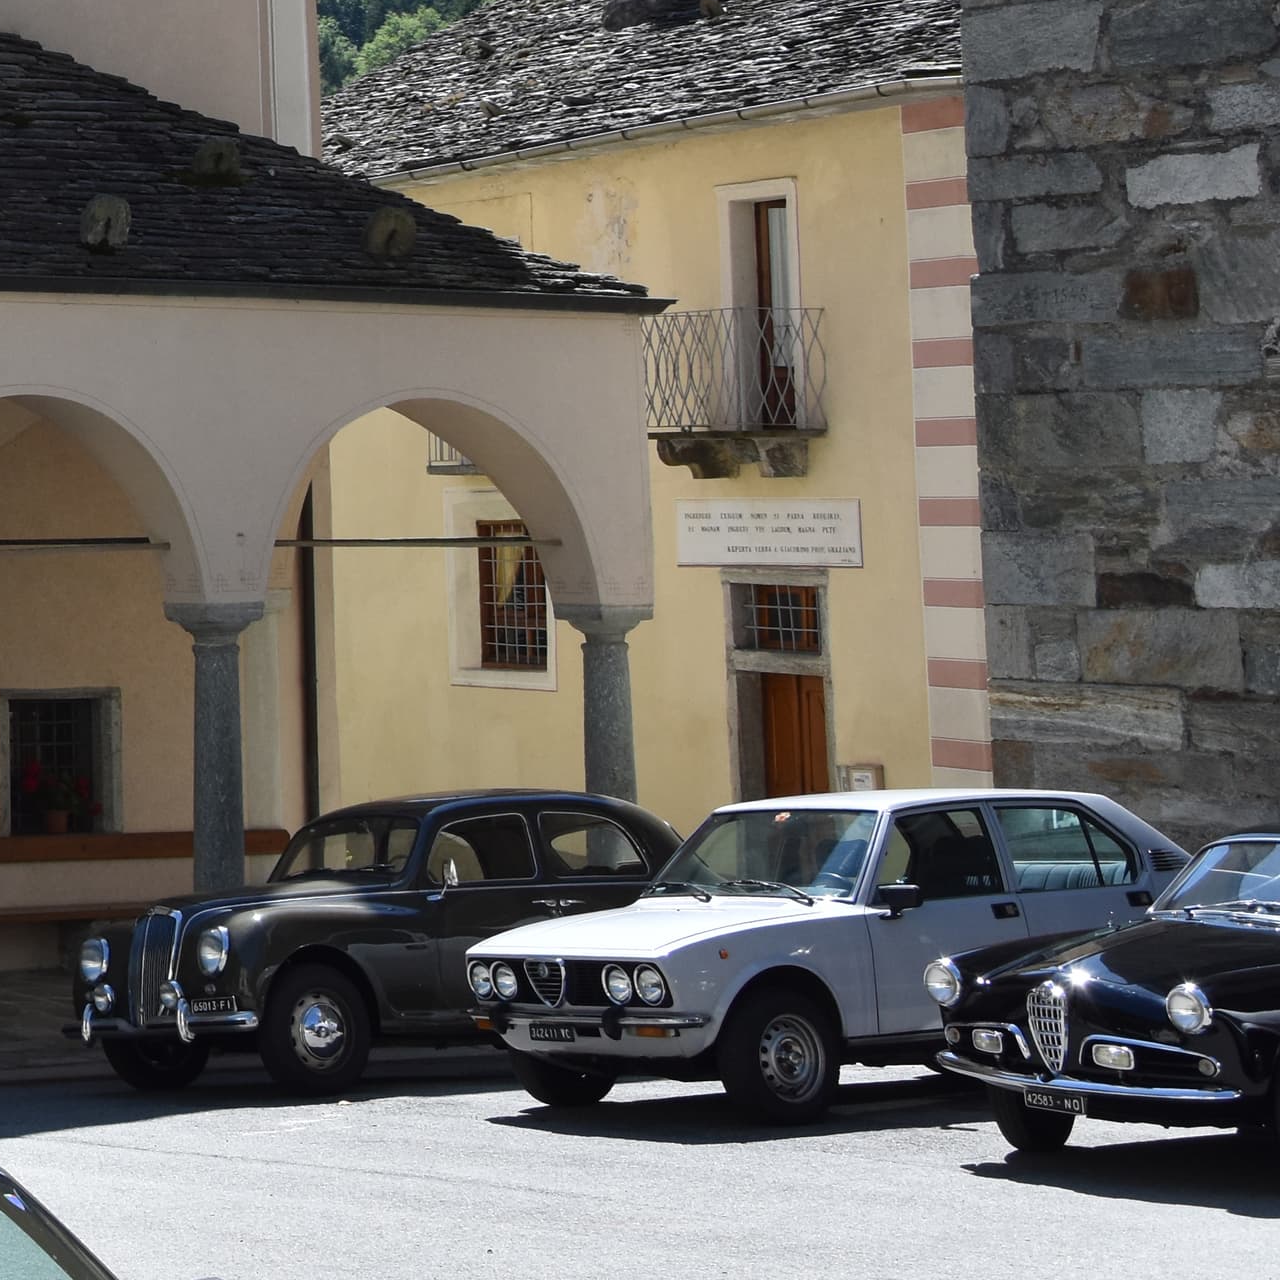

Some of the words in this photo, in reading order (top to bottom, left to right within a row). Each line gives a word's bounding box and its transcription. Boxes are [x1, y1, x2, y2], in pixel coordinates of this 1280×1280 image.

[193, 1000, 217, 1012] 65013
[219, 999, 231, 1010] FI
[1026, 1093, 1054, 1107] 42583
[1064, 1098, 1080, 1111] NO
